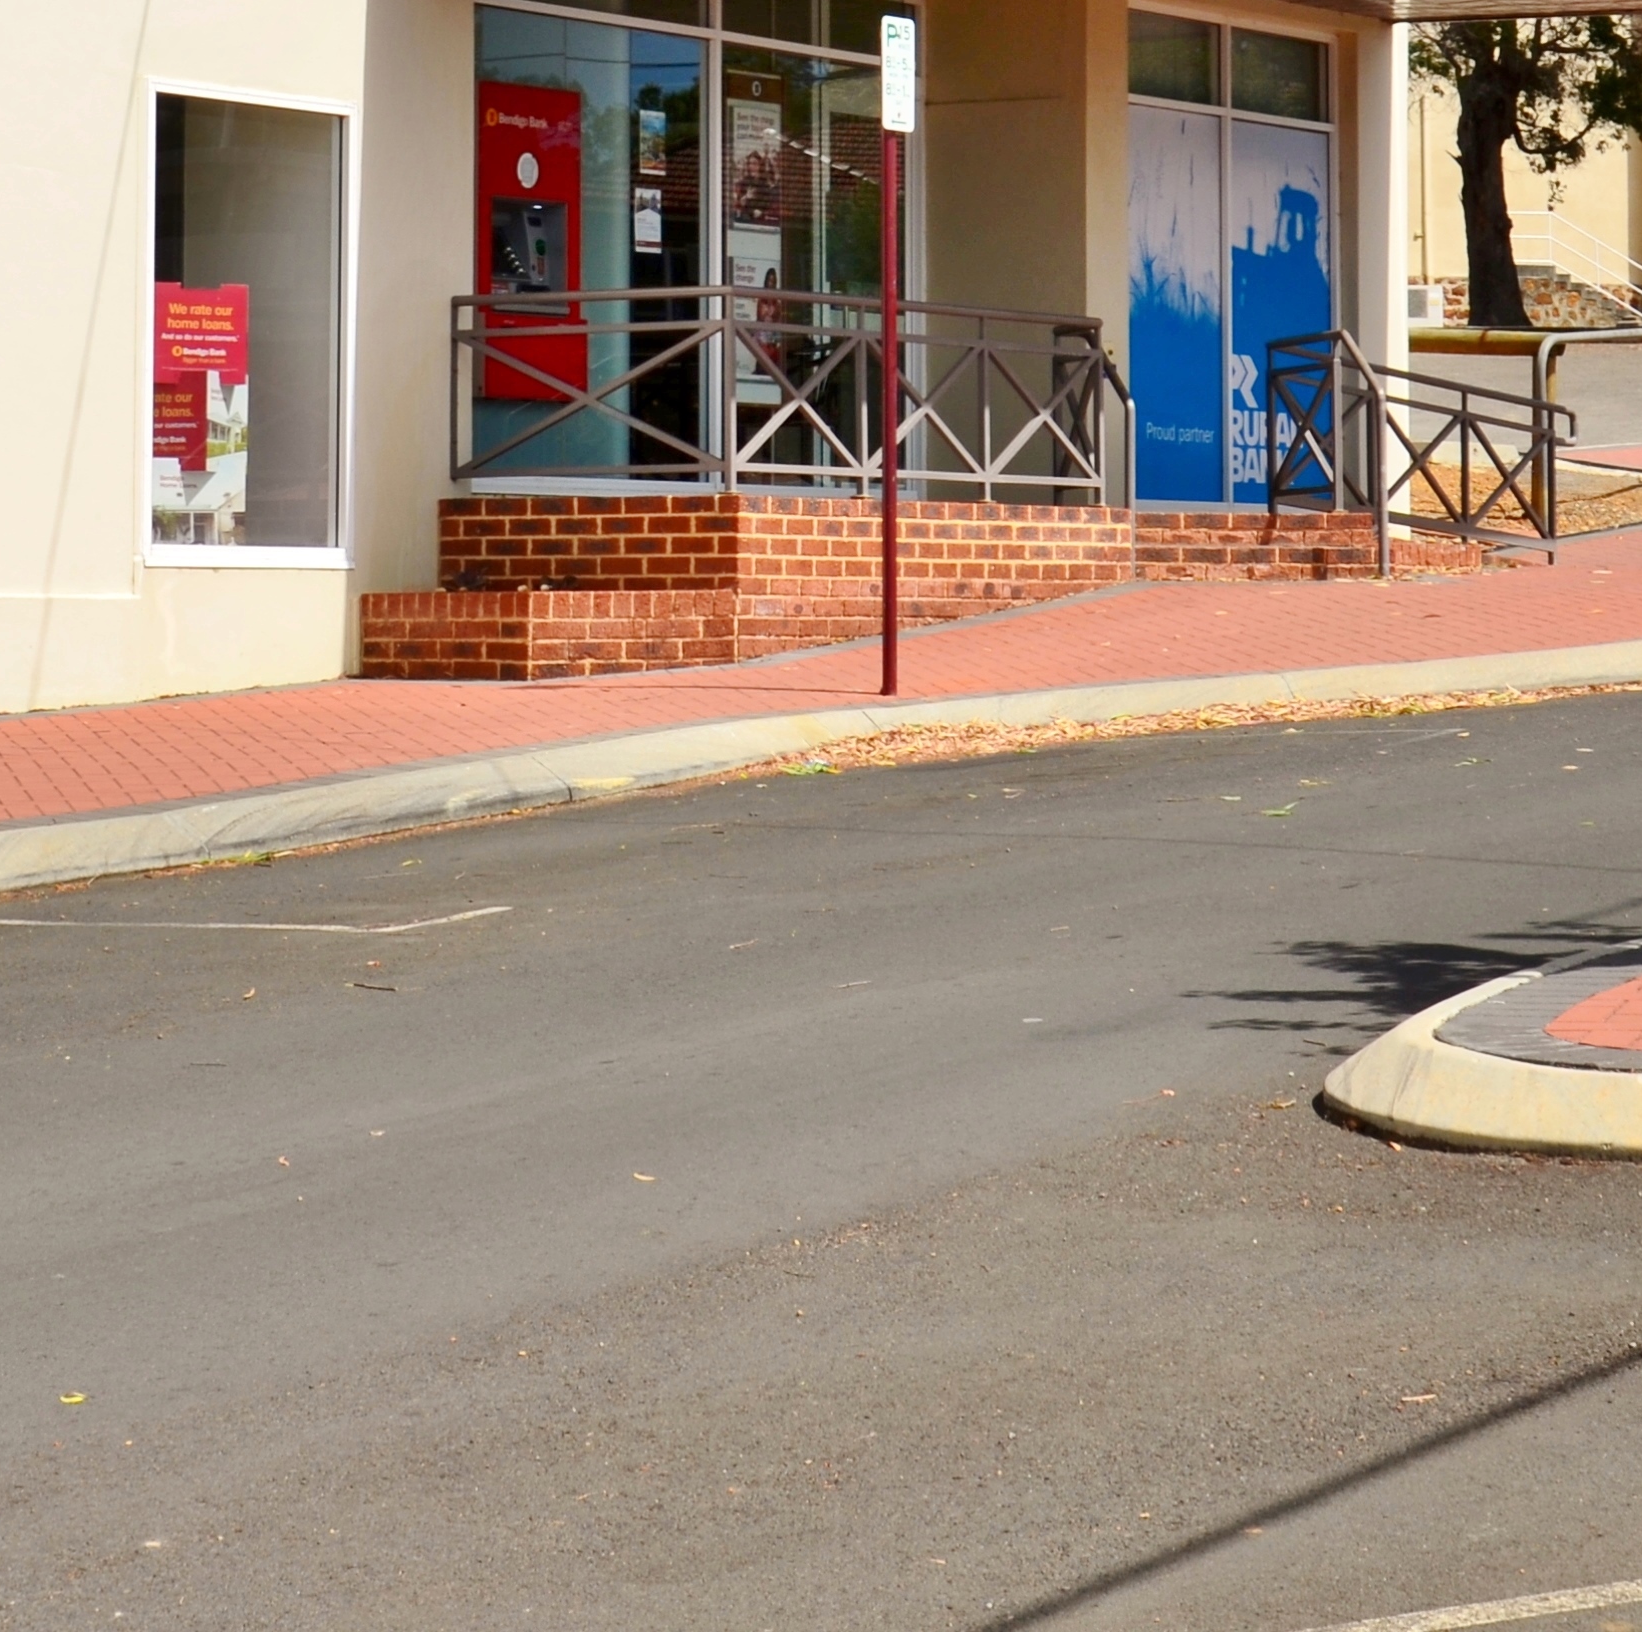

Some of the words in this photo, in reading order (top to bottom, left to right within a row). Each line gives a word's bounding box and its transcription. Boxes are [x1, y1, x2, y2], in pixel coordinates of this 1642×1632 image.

[529, 116, 548, 129] Bank
[168, 303, 188, 314] We
[190, 305, 212, 315] rate
[215, 306, 234, 316] our
[167, 317, 199, 329] home
[202, 319, 234, 331] loans.
[154, 394, 172, 403] ate
[175, 394, 193, 403] our
[162, 407, 194, 417] loans.
[1146, 422, 1176, 442] Proud
[1179, 428, 1215, 445] partner
